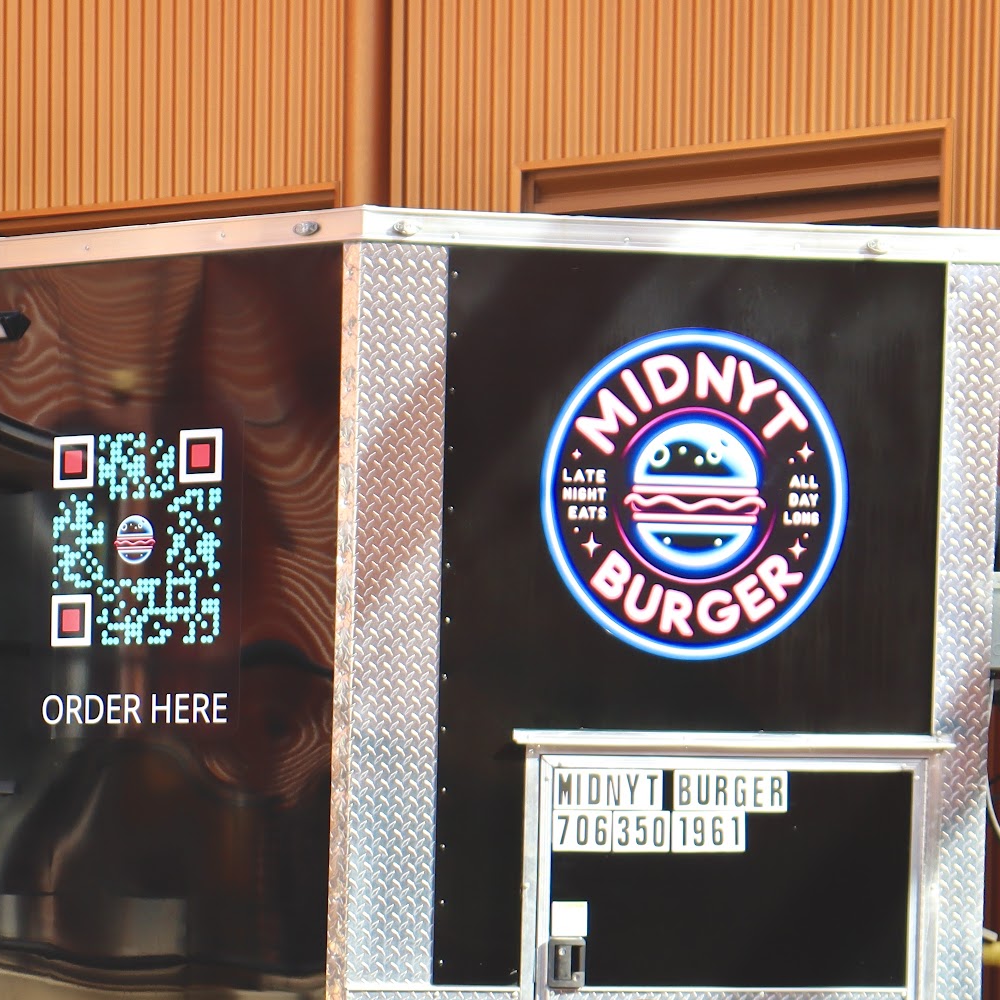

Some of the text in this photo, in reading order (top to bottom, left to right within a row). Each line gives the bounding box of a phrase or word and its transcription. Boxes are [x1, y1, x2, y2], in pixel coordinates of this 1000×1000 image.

[575, 351, 809, 456] MIDNYT
[562, 468, 607, 484] LATE
[789, 474, 819, 489] ALL
[562, 487, 607, 502] NIGHT
[788, 492, 820, 508] DAY
[568, 505, 607, 521] EATS
[783, 511, 820, 527] LONG
[589, 549, 804, 637] BURGER
[42, 692, 228, 725] ORDER HERE
[557, 772, 784, 808] MIDNYT BURGER
[679, 815, 740, 846] 1961
